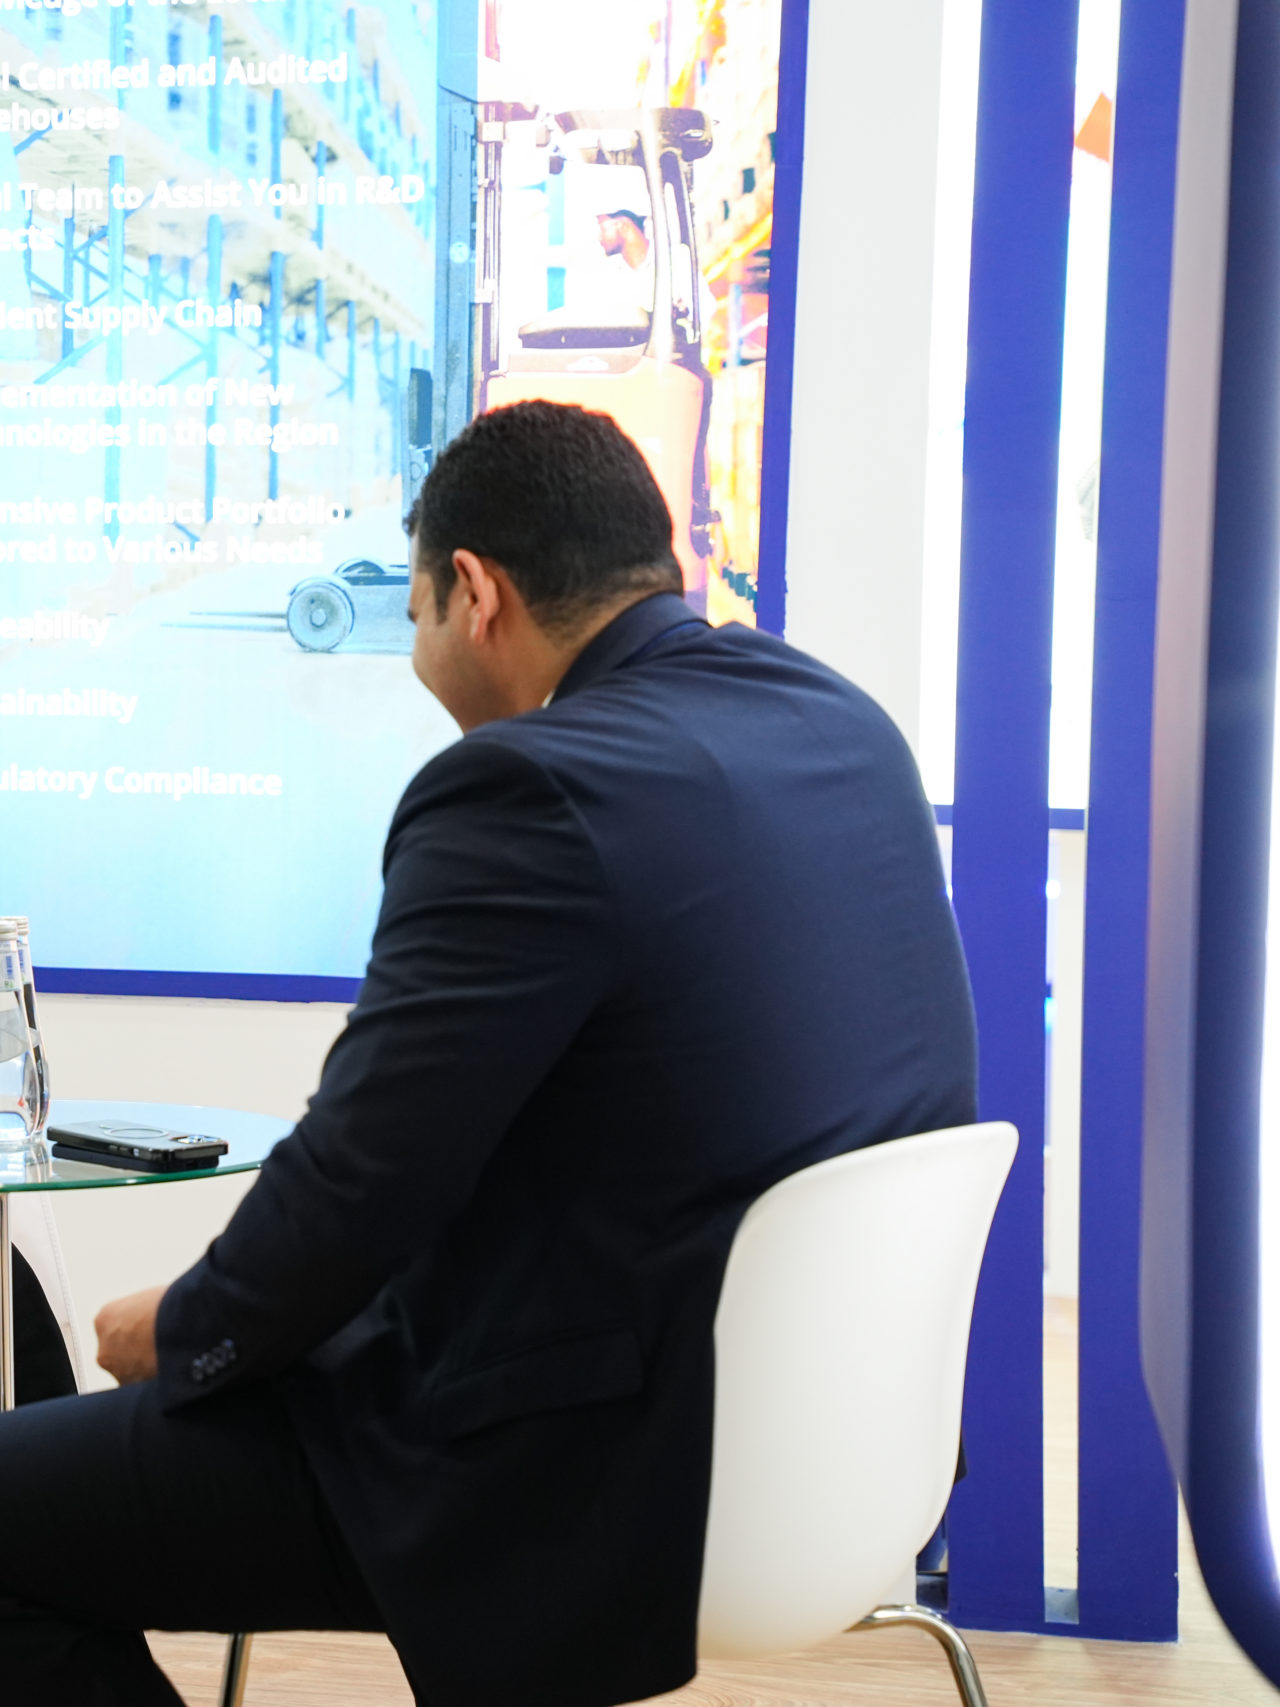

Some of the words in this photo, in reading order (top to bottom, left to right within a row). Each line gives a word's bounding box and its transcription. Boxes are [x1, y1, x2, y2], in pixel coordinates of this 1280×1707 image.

[18, 59, 148, 90] Certified
[158, 60, 215, 88] and
[225, 53, 348, 86] Audited
[22, 183, 103, 211] Team
[112, 182, 143, 210] to
[151, 179, 241, 209] Assist
[249, 178, 308, 206] You
[318, 176, 345, 205] in
[356, 174, 424, 205] R&D
[65, 300, 166, 338] Supply
[174, 298, 262, 328] Chain
[186, 379, 218, 406] of
[226, 380, 294, 405] New
[140, 417, 166, 446] in
[174, 416, 225, 446] the
[235, 418, 339, 453] Region
[86, 497, 205, 524] Product
[213, 496, 345, 523] Portfolio
[66, 538, 96, 562] to
[104, 536, 218, 563] Various
[227, 535, 322, 562] Needs
[105, 766, 282, 801] Compliance
